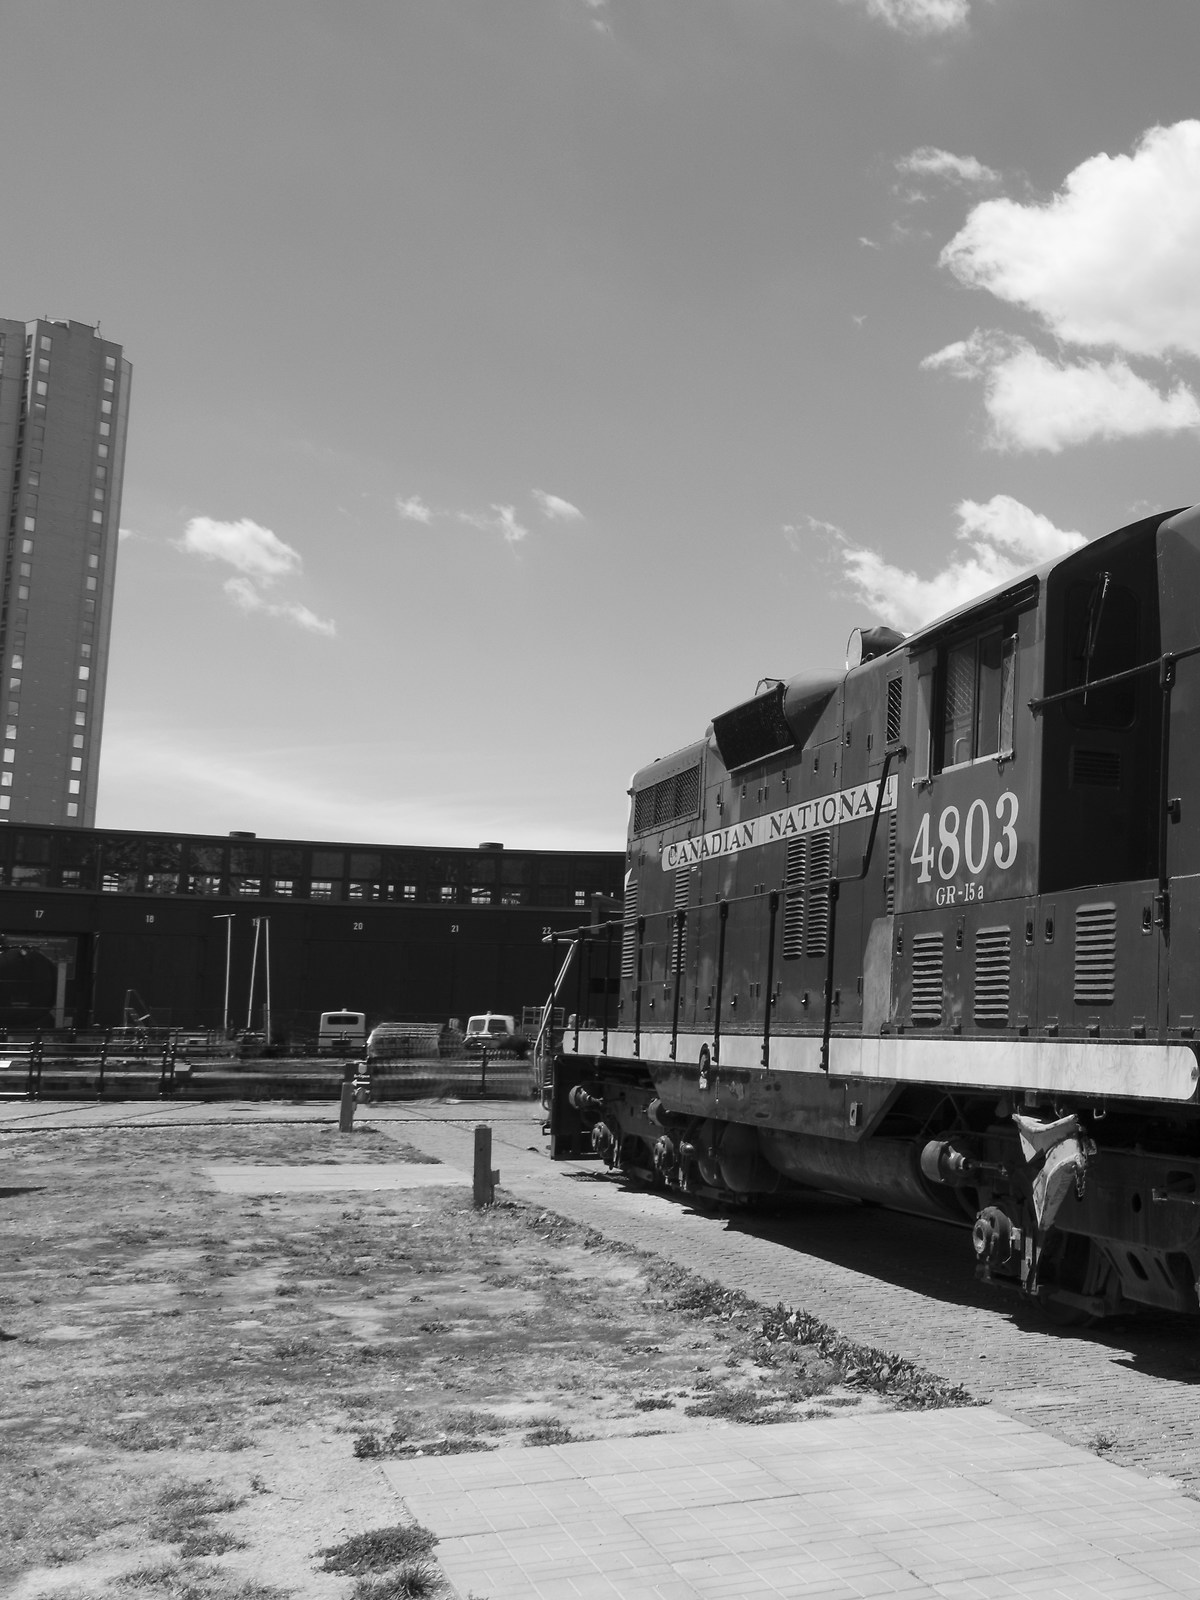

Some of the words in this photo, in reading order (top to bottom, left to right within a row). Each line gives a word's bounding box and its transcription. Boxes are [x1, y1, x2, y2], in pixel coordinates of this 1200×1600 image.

[910, 791, 1019, 884] 4803
[668, 822, 755, 867] CANADIAN
[35, 910, 44, 919] 17
[145, 915, 154, 923] 18
[353, 922, 363, 930] 20
[451, 924, 459, 933] 21
[542, 926, 552, 934] 22
